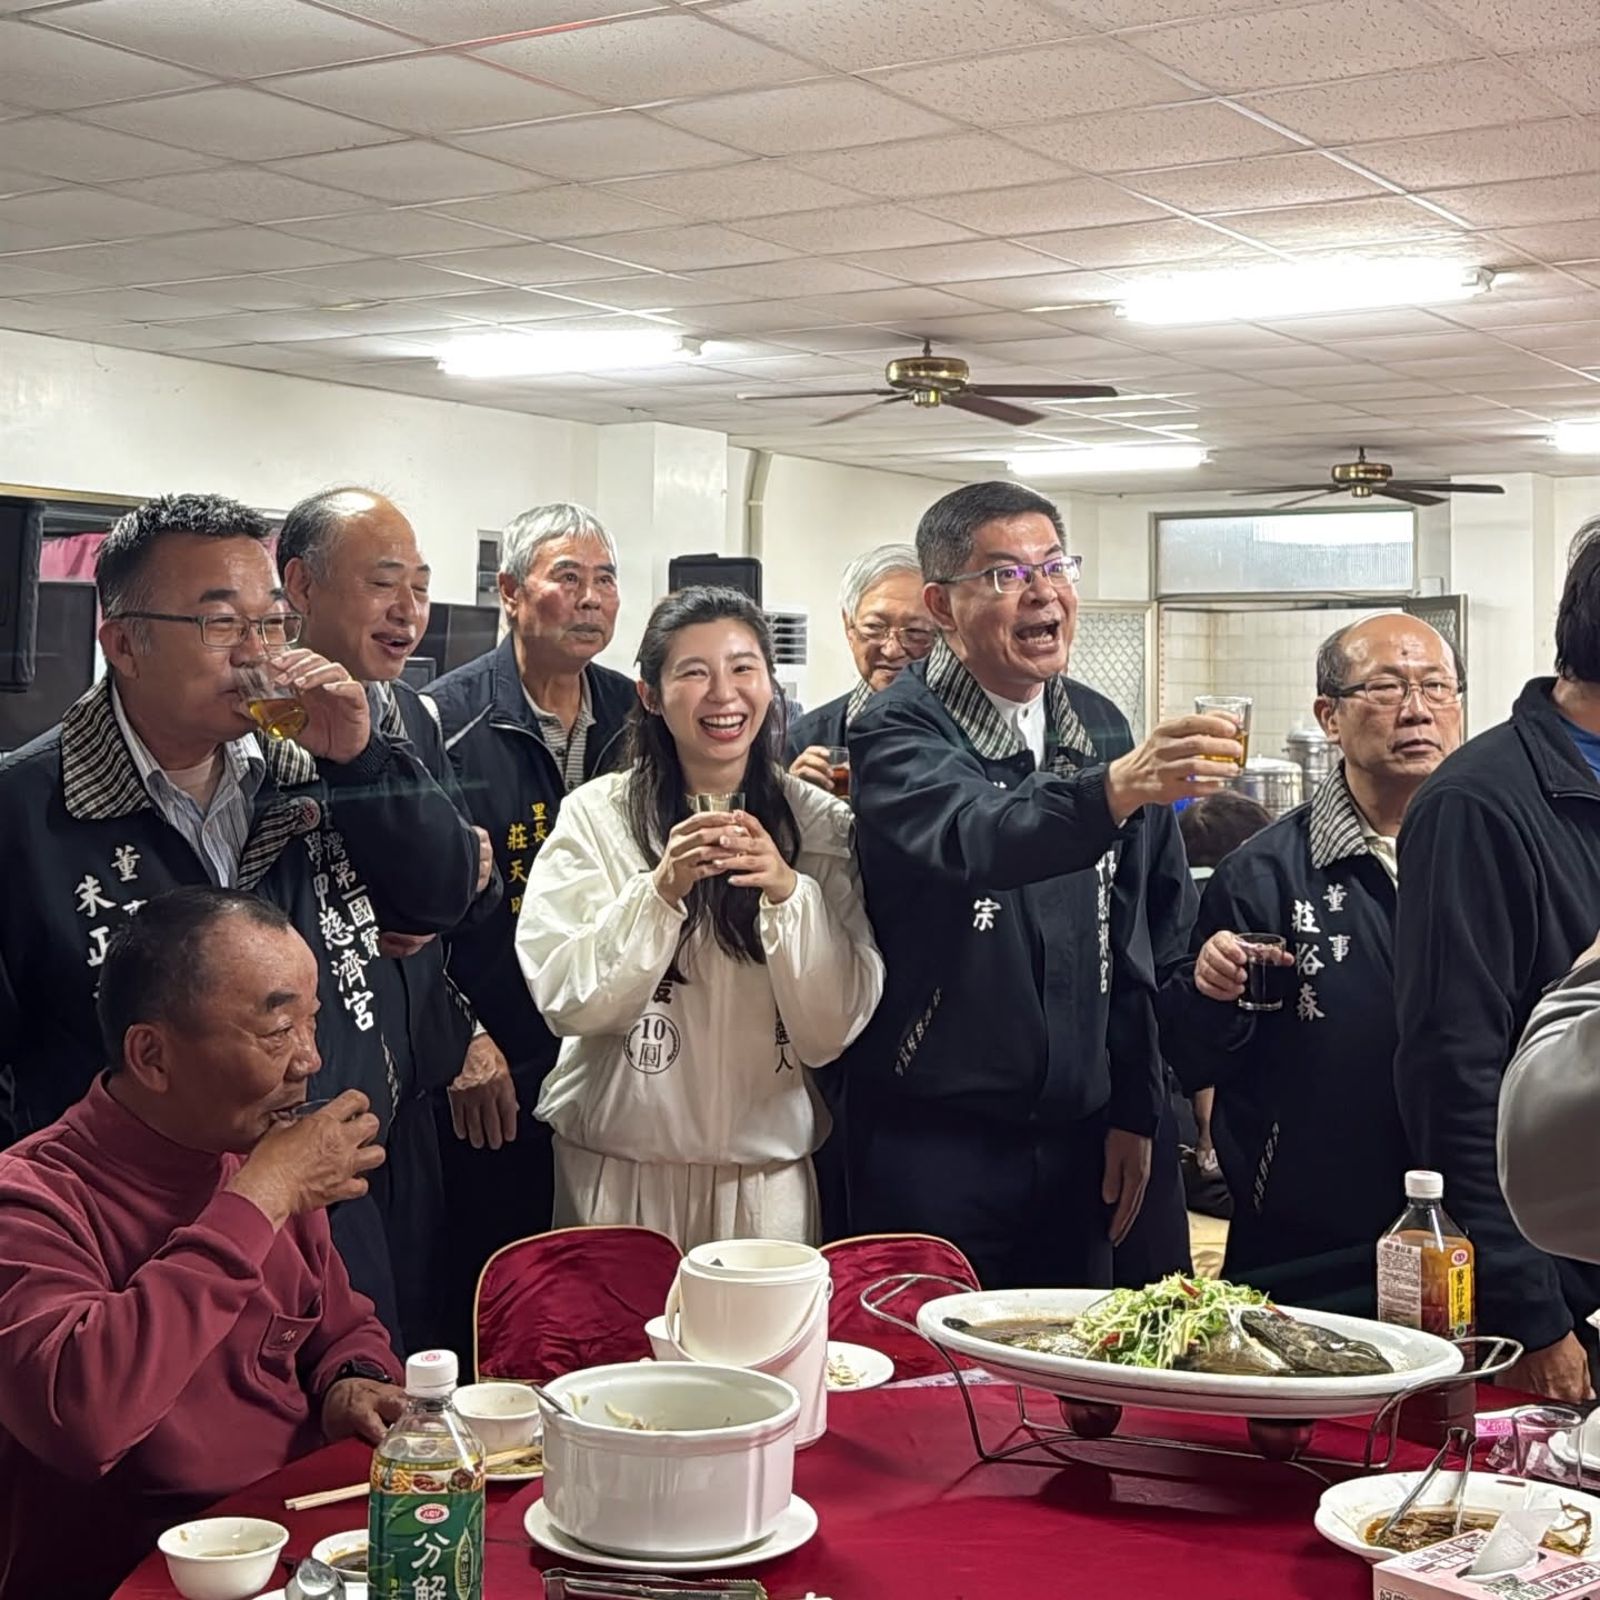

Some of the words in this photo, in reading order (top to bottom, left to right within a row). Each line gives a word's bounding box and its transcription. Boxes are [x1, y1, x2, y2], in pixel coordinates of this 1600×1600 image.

[531, 802, 548, 842] 里長
[972, 897, 1003, 932] 宗
[1323, 883, 1351, 963] 董事
[640, 1018, 667, 1041] 10
